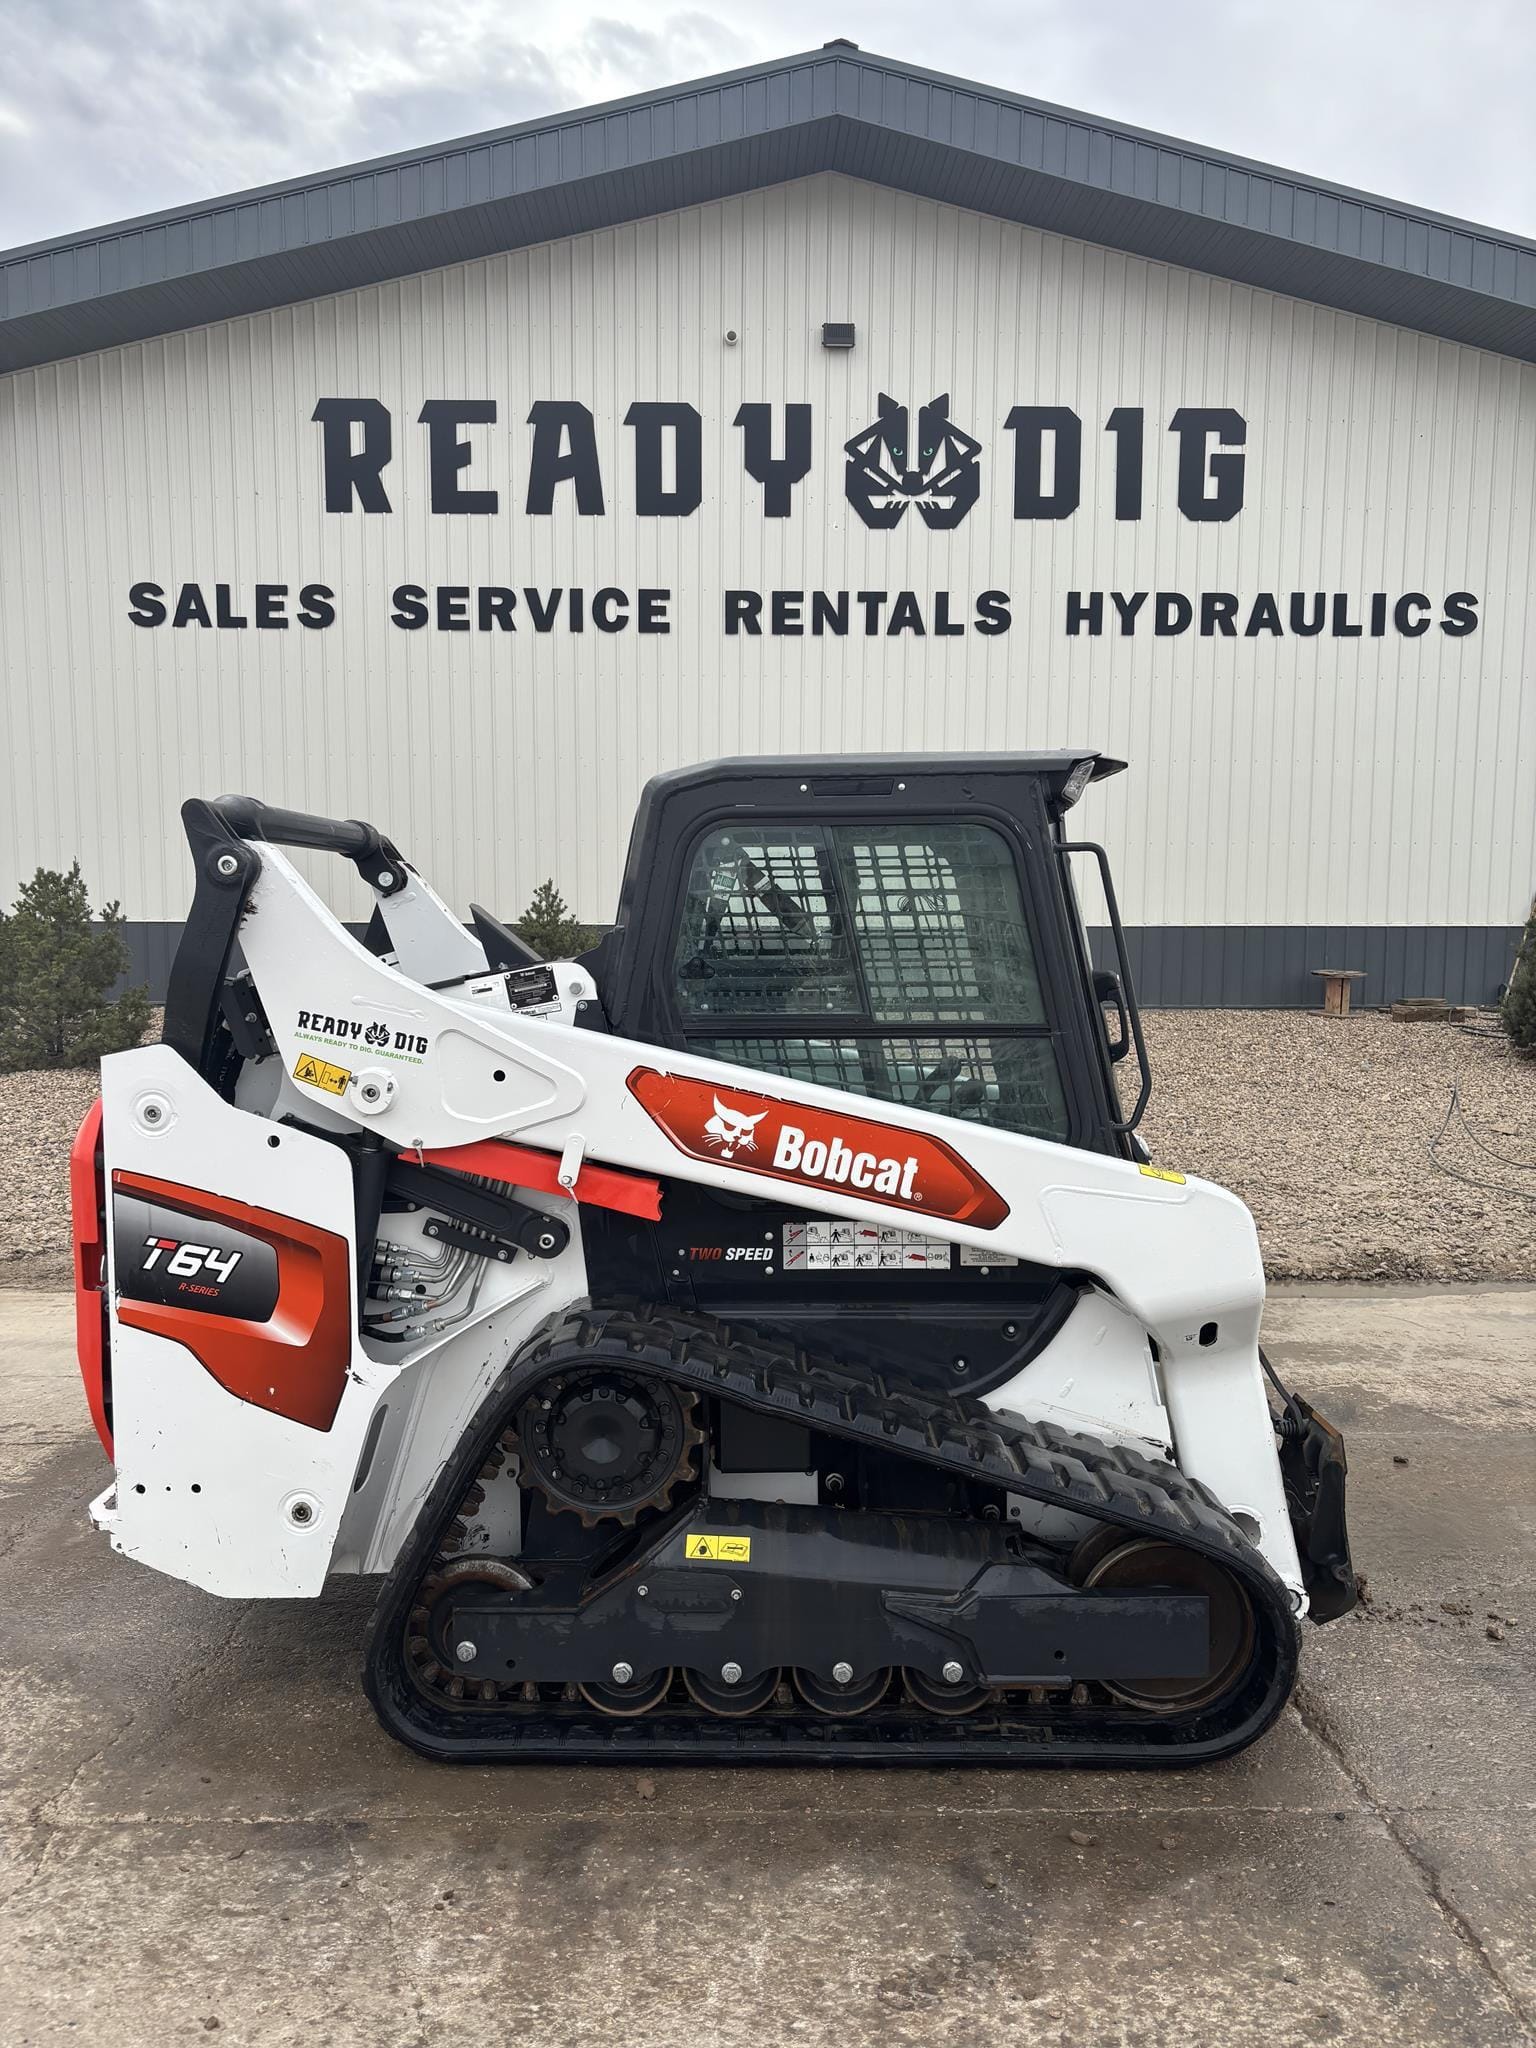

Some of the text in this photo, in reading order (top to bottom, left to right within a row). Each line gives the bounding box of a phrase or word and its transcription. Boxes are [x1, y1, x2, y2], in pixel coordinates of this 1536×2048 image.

[311, 397, 1247, 522] READY DIG
[128, 582, 1479, 638] SALES SERVICE RENTALS HYDRAULICS
[294, 1031, 424, 1065] ALWAYS READY TO DIG. GUARANTEED.
[297, 1010, 429, 1054] READY DIG
[773, 1124, 919, 1200] Bobcat
[142, 1236, 243, 1284] T64
[690, 1247, 774, 1261] TWO SPEED
[178, 1281, 220, 1297] R-SERIES
